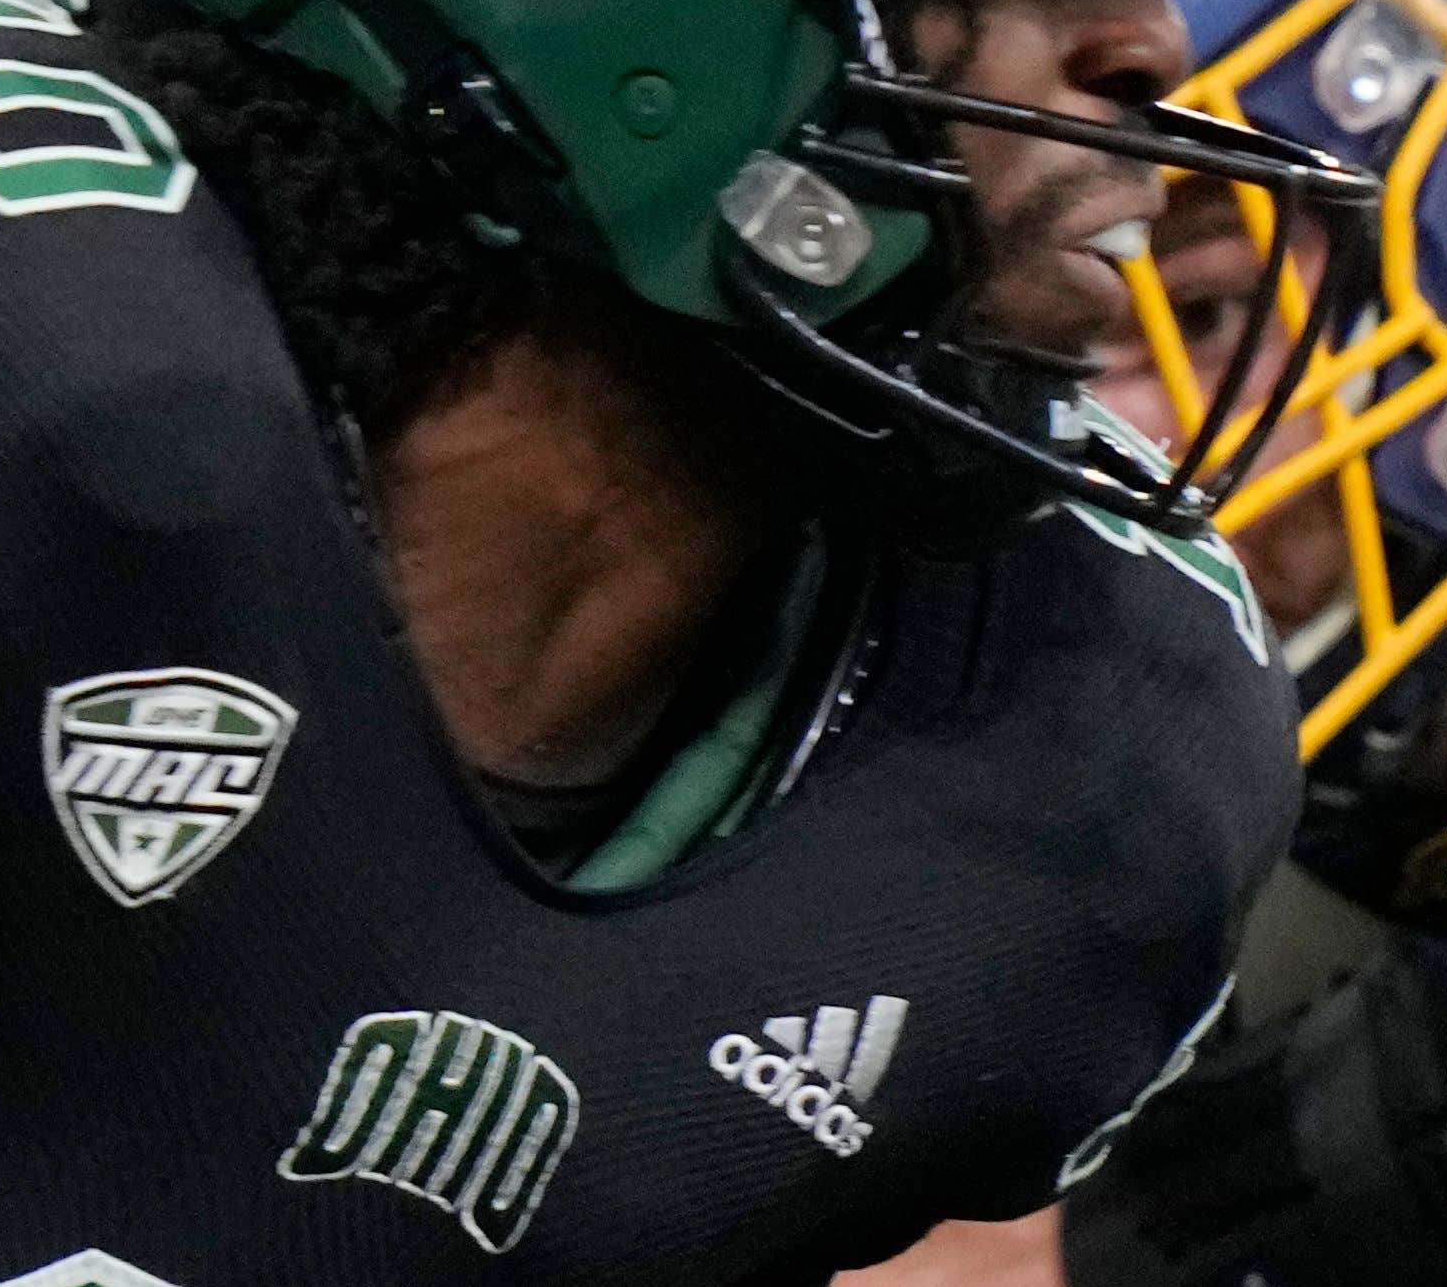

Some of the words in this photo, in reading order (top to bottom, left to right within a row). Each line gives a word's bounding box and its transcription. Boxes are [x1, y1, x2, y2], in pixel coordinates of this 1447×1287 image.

[54, 740, 264, 812] MAC
[278, 1010, 581, 1254] OHIO
[708, 1033, 874, 1158] adidas
